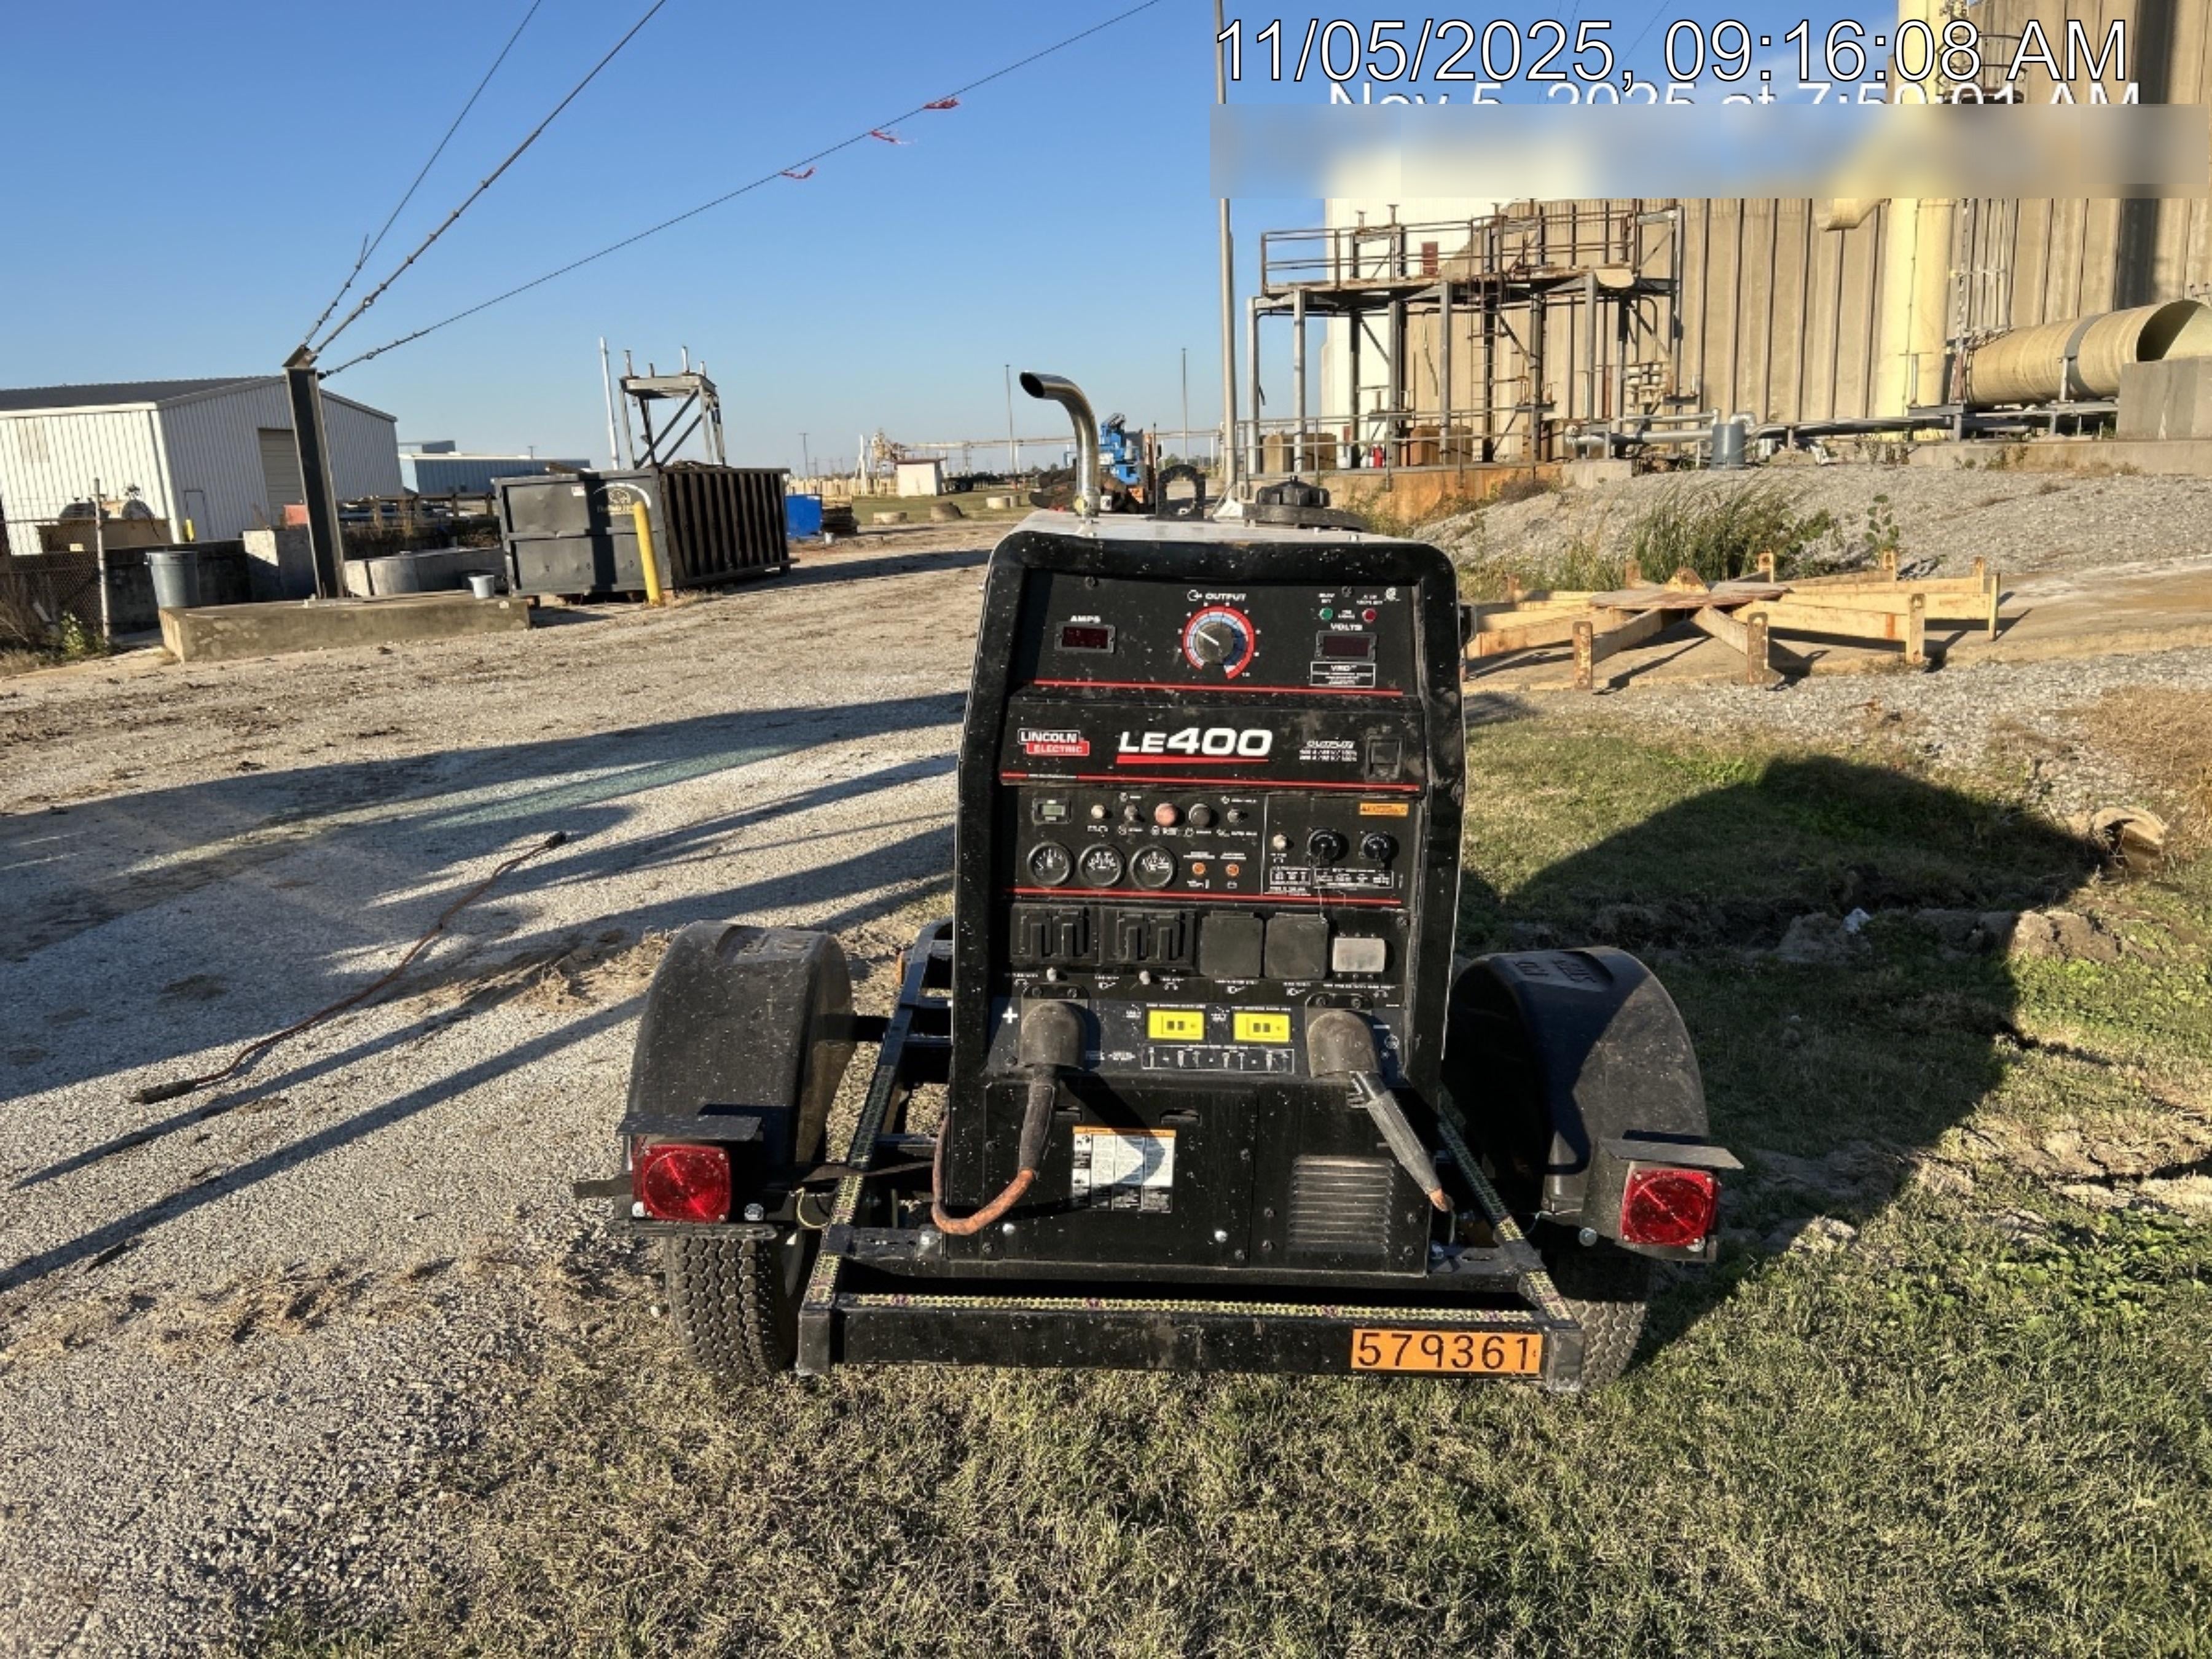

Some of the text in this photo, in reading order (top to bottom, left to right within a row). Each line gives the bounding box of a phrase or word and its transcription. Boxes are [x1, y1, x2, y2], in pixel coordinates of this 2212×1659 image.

[1205, 592, 1247, 602] OUTPUT
[1070, 614, 1101, 624] AMPS
[1330, 622, 1363, 631] VOLTS
[1020, 731, 1078, 743] LINCOLN
[1118, 727, 1273, 756] LE400
[1033, 744, 1083, 754] ELECTRIC
[1357, 1332, 1529, 1370] 579361
